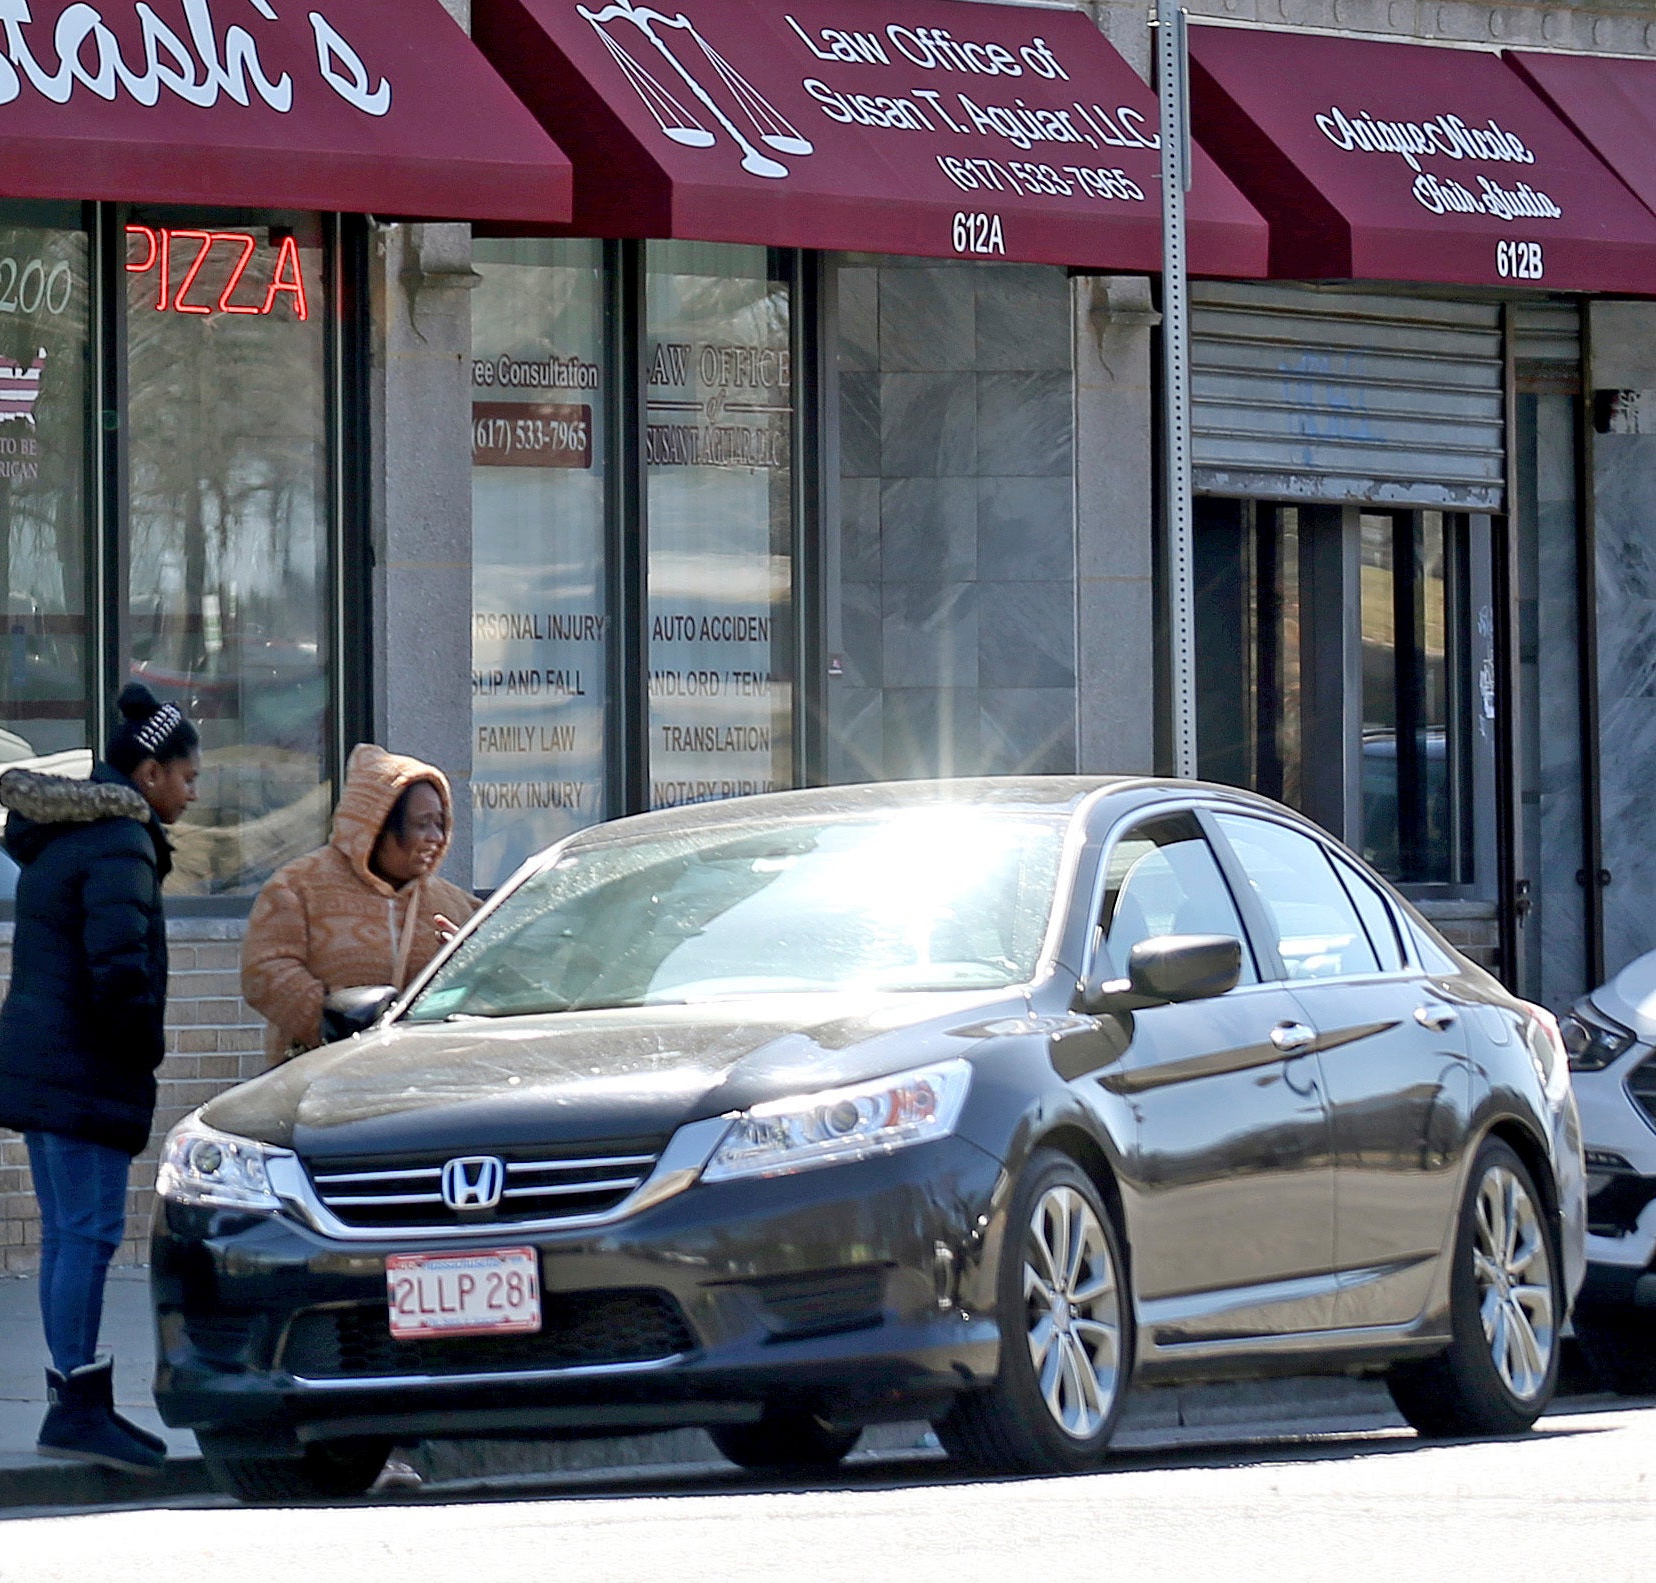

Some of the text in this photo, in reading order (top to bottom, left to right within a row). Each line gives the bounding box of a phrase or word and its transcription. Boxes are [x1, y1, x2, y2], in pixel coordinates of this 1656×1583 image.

[784, 13, 1071, 82] Law Office of
[802, 77, 924, 132] Susan
[911, 89, 972, 136] T.
[960, 91, 1098, 151] Aguiar,
[1314, 105, 1437, 173] Anique
[935, 154, 1146, 203] (617) 533-7965
[952, 212, 1007, 257] 612A
[124, 224, 310, 322] PIZZA
[1496, 239, 1545, 280] 612B
[496, 353, 599, 390] Consultation
[646, 343, 692, 387] AW
[20, 437, 38, 456] BE
[515, 419, 588, 452] 533-7965
[546, 614, 606, 641] INJURY
[652, 614, 772, 643] AUTO ACCIDEN
[471, 669, 586, 697] SLIP AND FALL
[478, 725, 577, 753] FAMILY LAW
[661, 725, 770, 752] TRANSLATION
[472, 781, 584, 809] WORK INJURY
[653, 779, 718, 808] NOTARY
[396, 1271, 525, 1315] 2LLP 28
